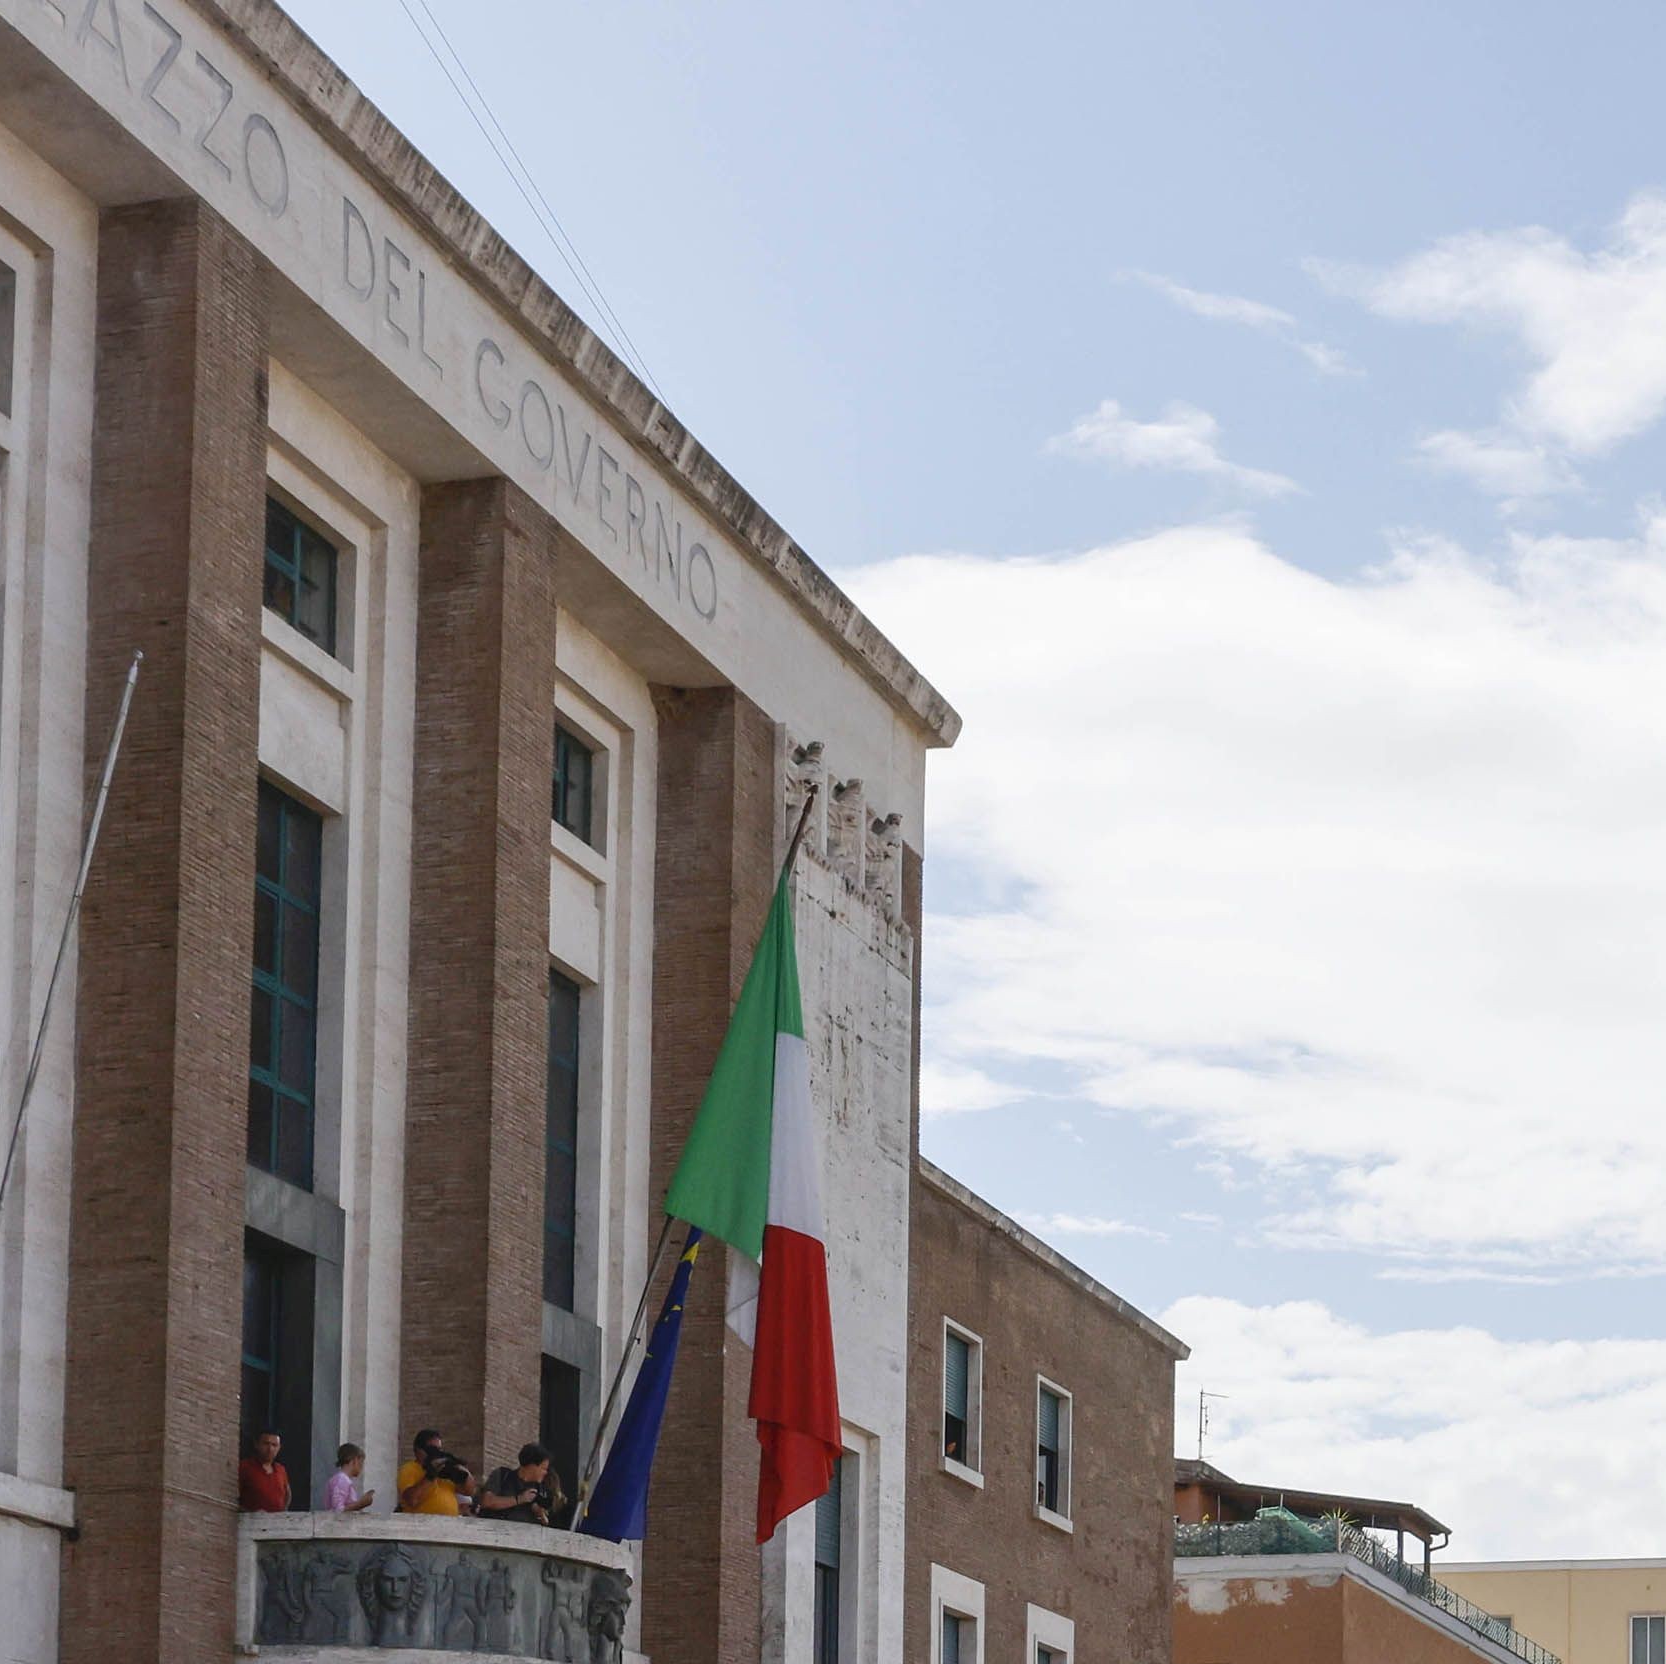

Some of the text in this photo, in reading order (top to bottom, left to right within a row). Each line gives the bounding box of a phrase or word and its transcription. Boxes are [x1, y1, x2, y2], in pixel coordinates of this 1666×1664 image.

[38, 0, 718, 624] AZZO DEL GOVERNO
